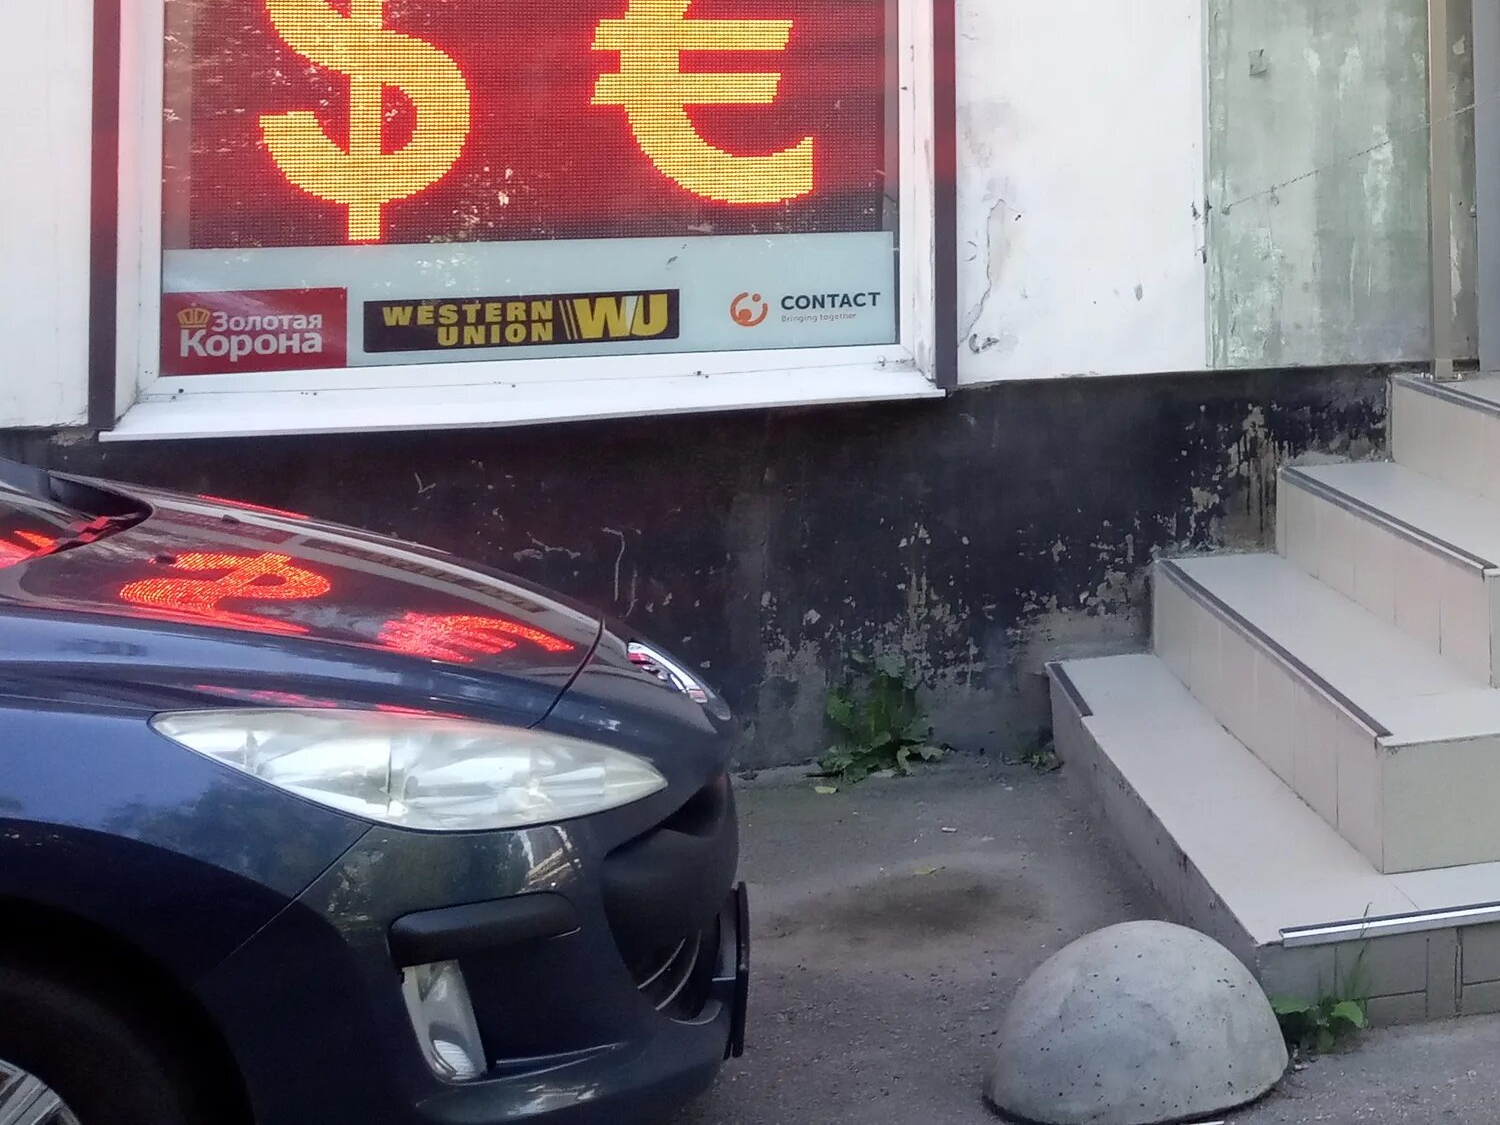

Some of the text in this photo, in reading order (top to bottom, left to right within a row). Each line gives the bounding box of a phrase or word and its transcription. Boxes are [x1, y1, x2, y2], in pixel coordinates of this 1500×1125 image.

[382, 299, 554, 326] WESTERN
[780, 291, 881, 311] CONTACT
[210, 310, 323, 332] Золотая
[576, 293, 669, 339] WU
[780, 312, 857, 323] Bringing together
[179, 330, 323, 363] Корона
[437, 320, 554, 347] UNION
